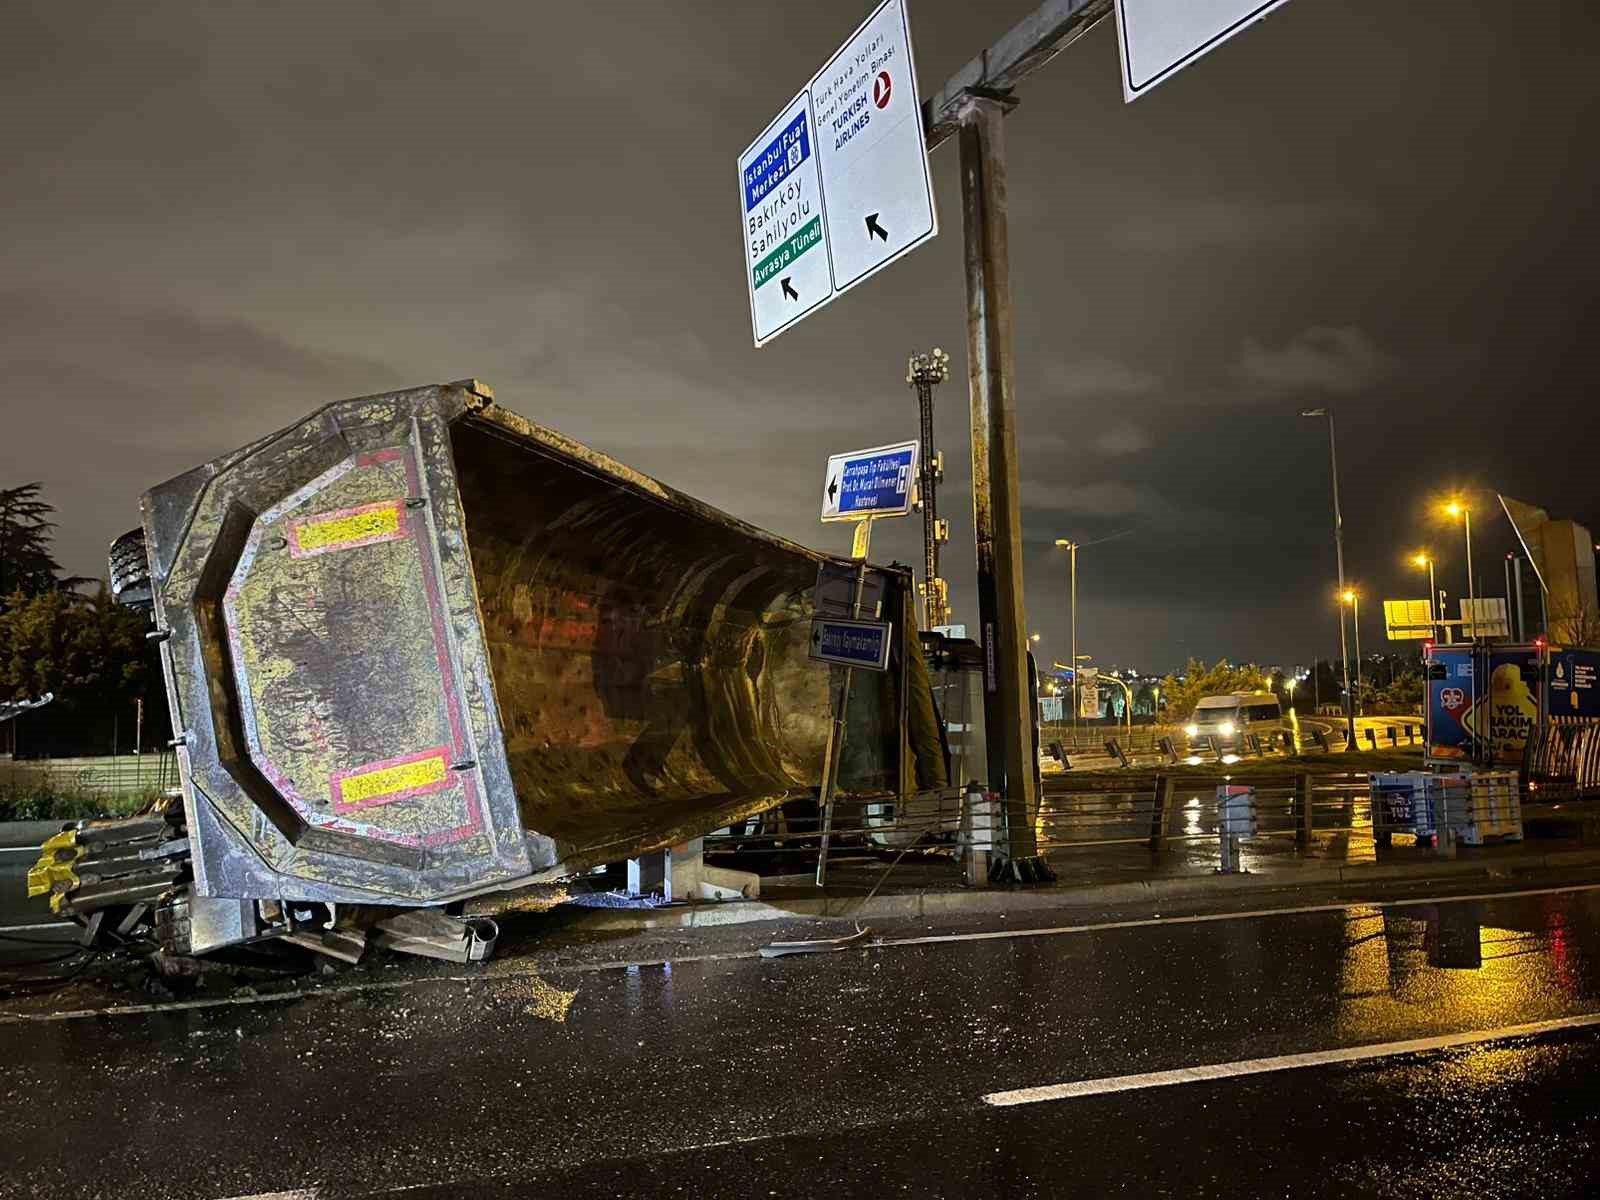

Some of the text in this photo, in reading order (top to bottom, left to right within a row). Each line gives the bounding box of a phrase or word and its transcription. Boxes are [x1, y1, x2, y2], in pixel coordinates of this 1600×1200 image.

[834, 66, 853, 90] Hava
[818, 102, 838, 127] Genel
[832, 92, 868, 133] TURKISH
[835, 111, 871, 151] AIRLINES
[783, 120, 805, 151] Fuar
[751, 159, 787, 203] Merkezi
[748, 178, 802, 236] Bakırköy
[751, 200, 810, 259] Sahilyolu
[754, 221, 821, 285] Avrasya Tüneli
[1495, 704, 1524, 716] YOL
